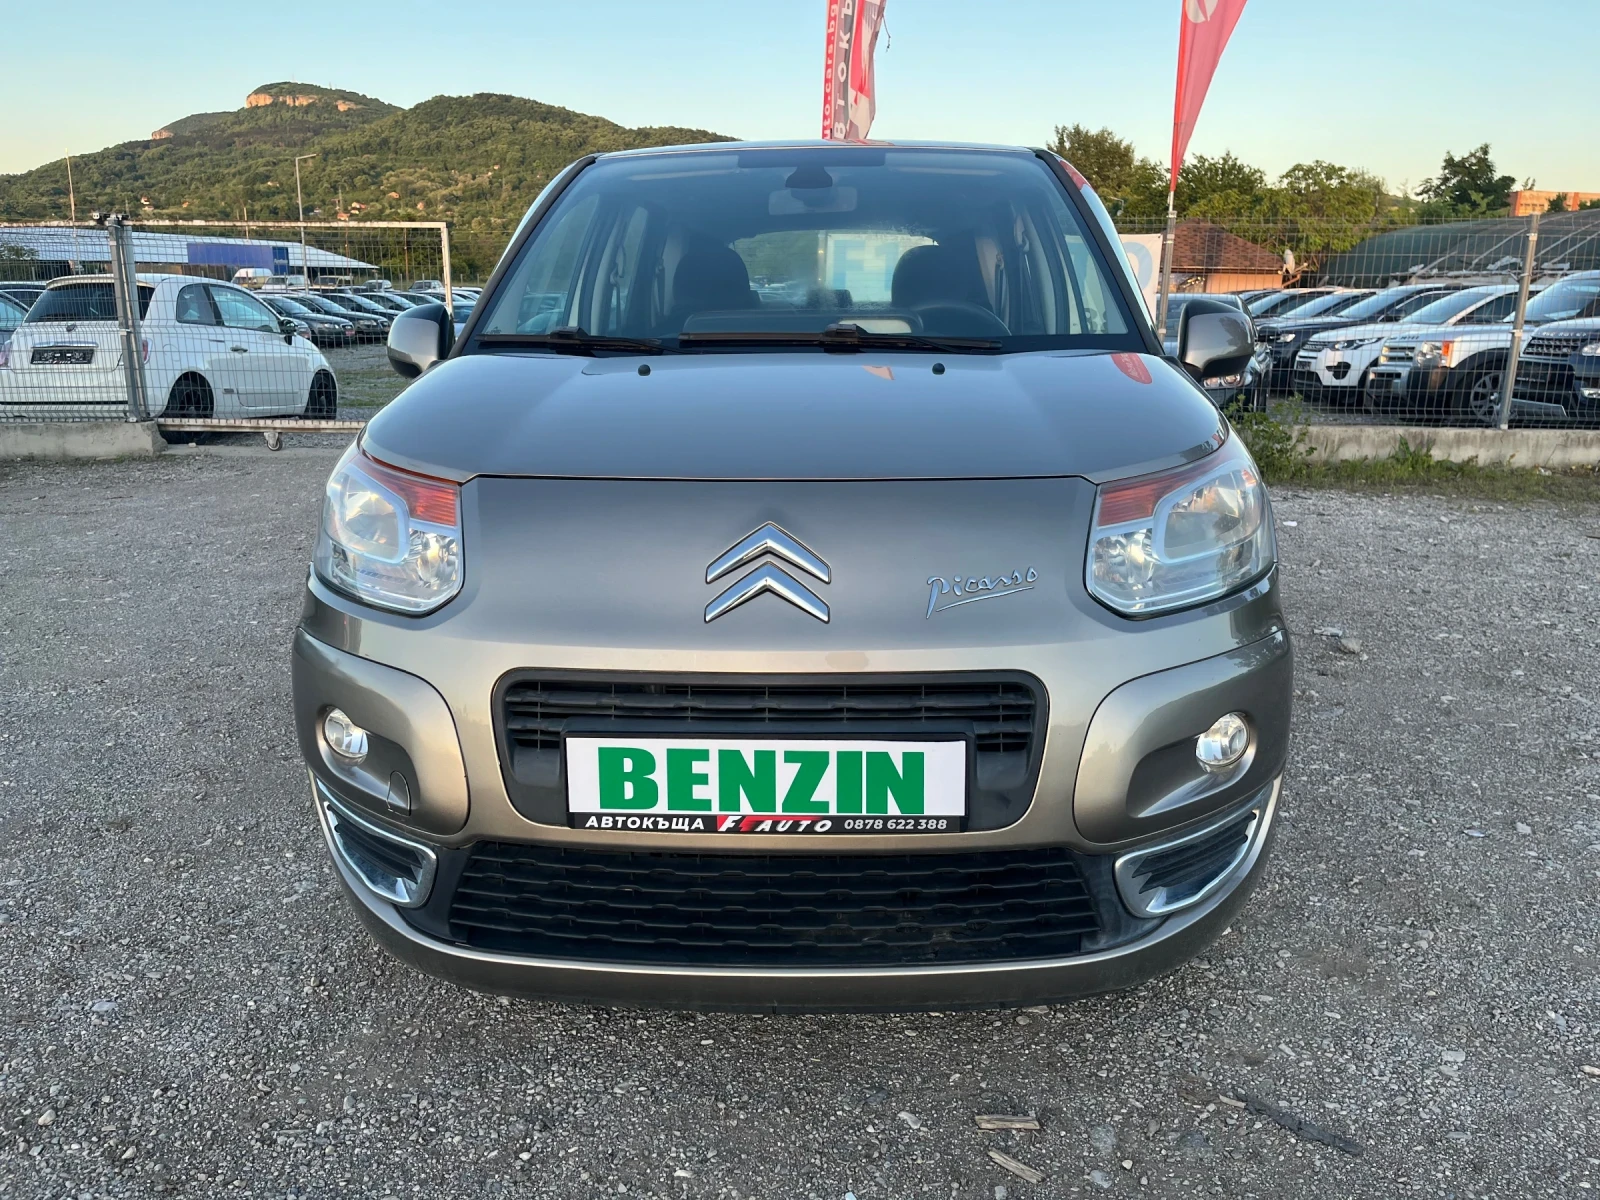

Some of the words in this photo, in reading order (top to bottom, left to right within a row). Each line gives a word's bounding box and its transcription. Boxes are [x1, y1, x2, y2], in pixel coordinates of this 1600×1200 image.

[823, 4, 838, 139] uto.cars.bg
[833, 0, 853, 139] ВТОКЪ
[926, 566, 1039, 619] Picasso
[598, 747, 925, 814] BENZIN
[585, 815, 705, 831] АВТОКЪЩА
[754, 820, 832, 832] AUTO
[844, 819, 884, 830] 0878
[887, 819, 915, 830] 622
[917, 819, 948, 830] 388
